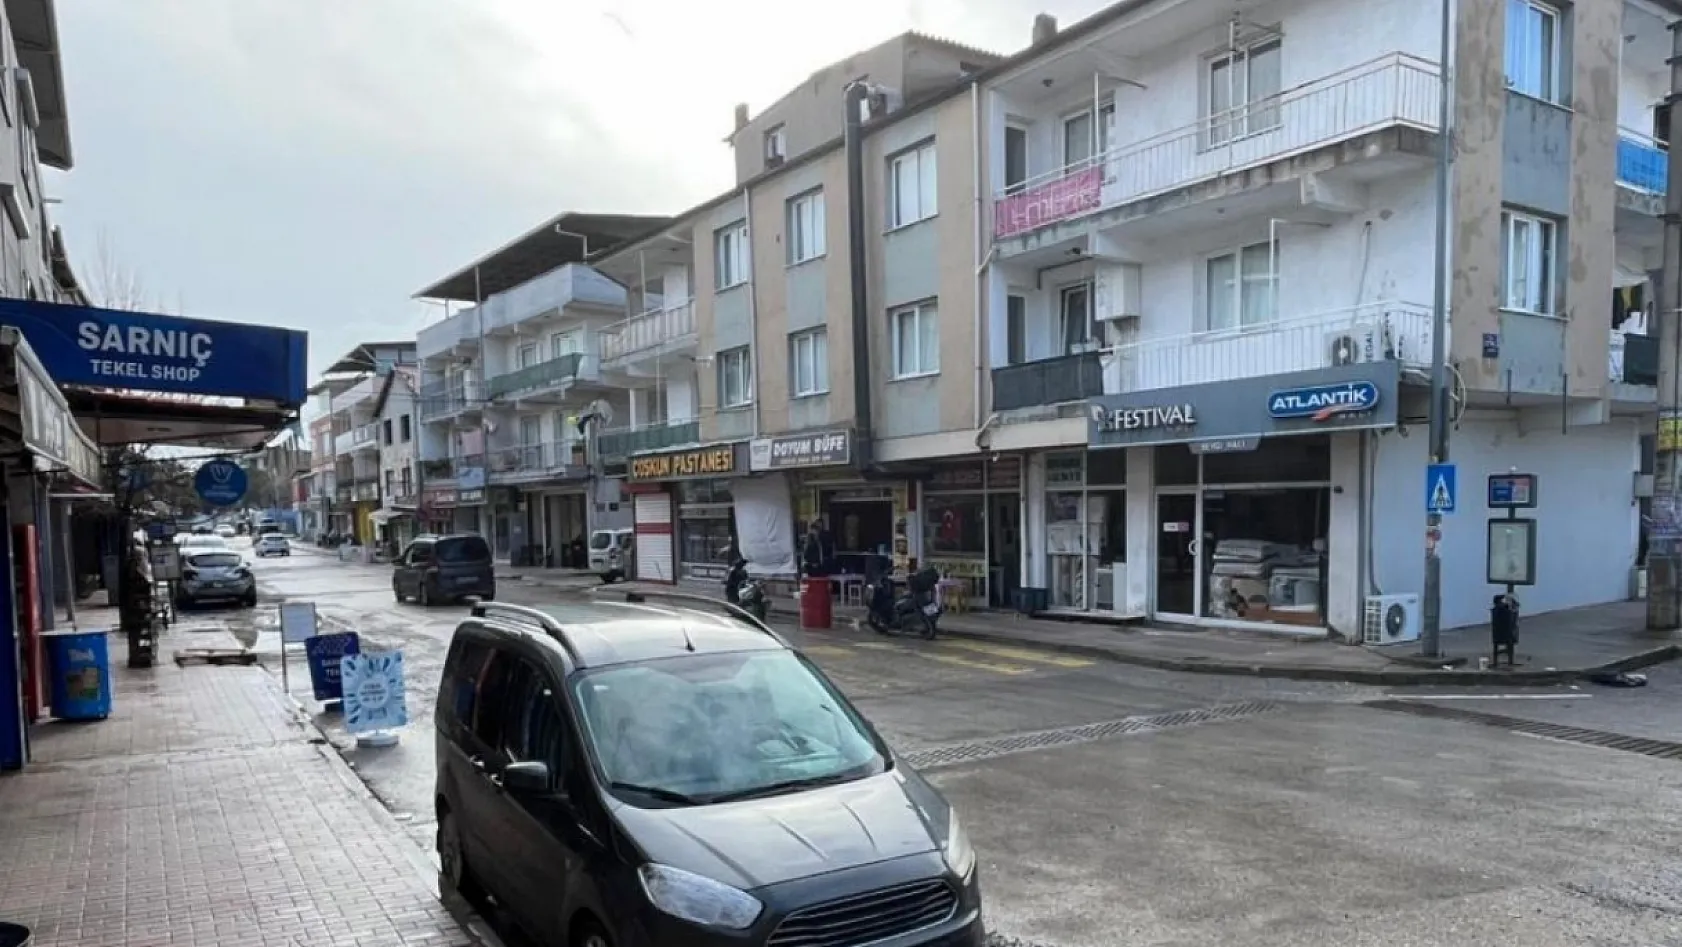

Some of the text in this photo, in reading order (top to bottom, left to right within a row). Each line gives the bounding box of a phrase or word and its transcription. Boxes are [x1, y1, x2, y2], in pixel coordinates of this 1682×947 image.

[77, 321, 213, 367] SARNIÇ
[89, 358, 201, 382] TEKEL SHOP
[1272, 384, 1368, 410] ATLANTİK
[1115, 404, 1197, 430] FESTIVAL
